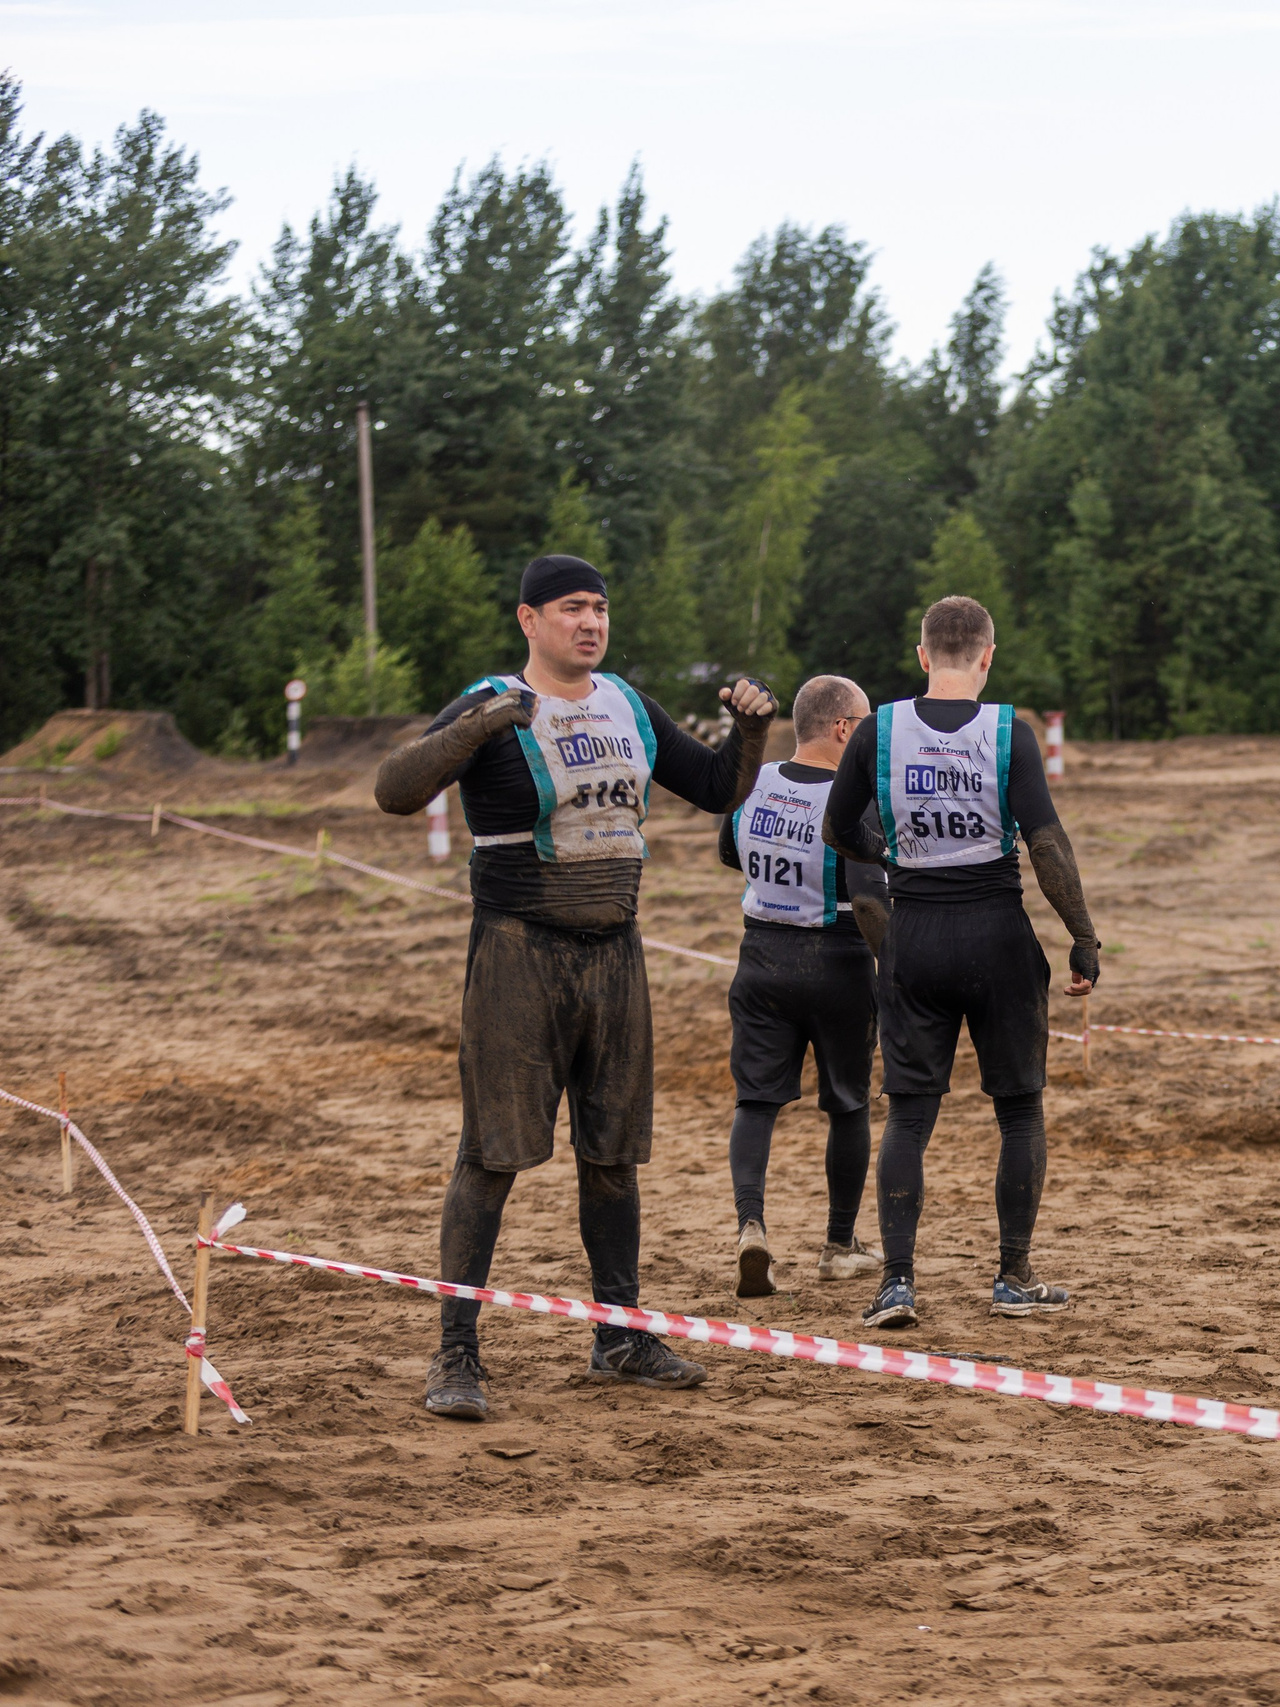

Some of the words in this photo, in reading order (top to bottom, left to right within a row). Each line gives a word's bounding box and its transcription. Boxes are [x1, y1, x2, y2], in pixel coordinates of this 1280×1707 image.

[560, 735, 634, 764] RODVIG
[919, 746, 941, 754] ГОНКА
[941, 747, 970, 758] ГЕРОЕВ
[908, 768, 983, 793] RODVIG
[753, 811, 815, 845] RODVIG
[910, 811, 986, 839] 5163
[748, 850, 804, 887] 6121
[761, 901, 800, 912] ГАЗПРОМБАНК
